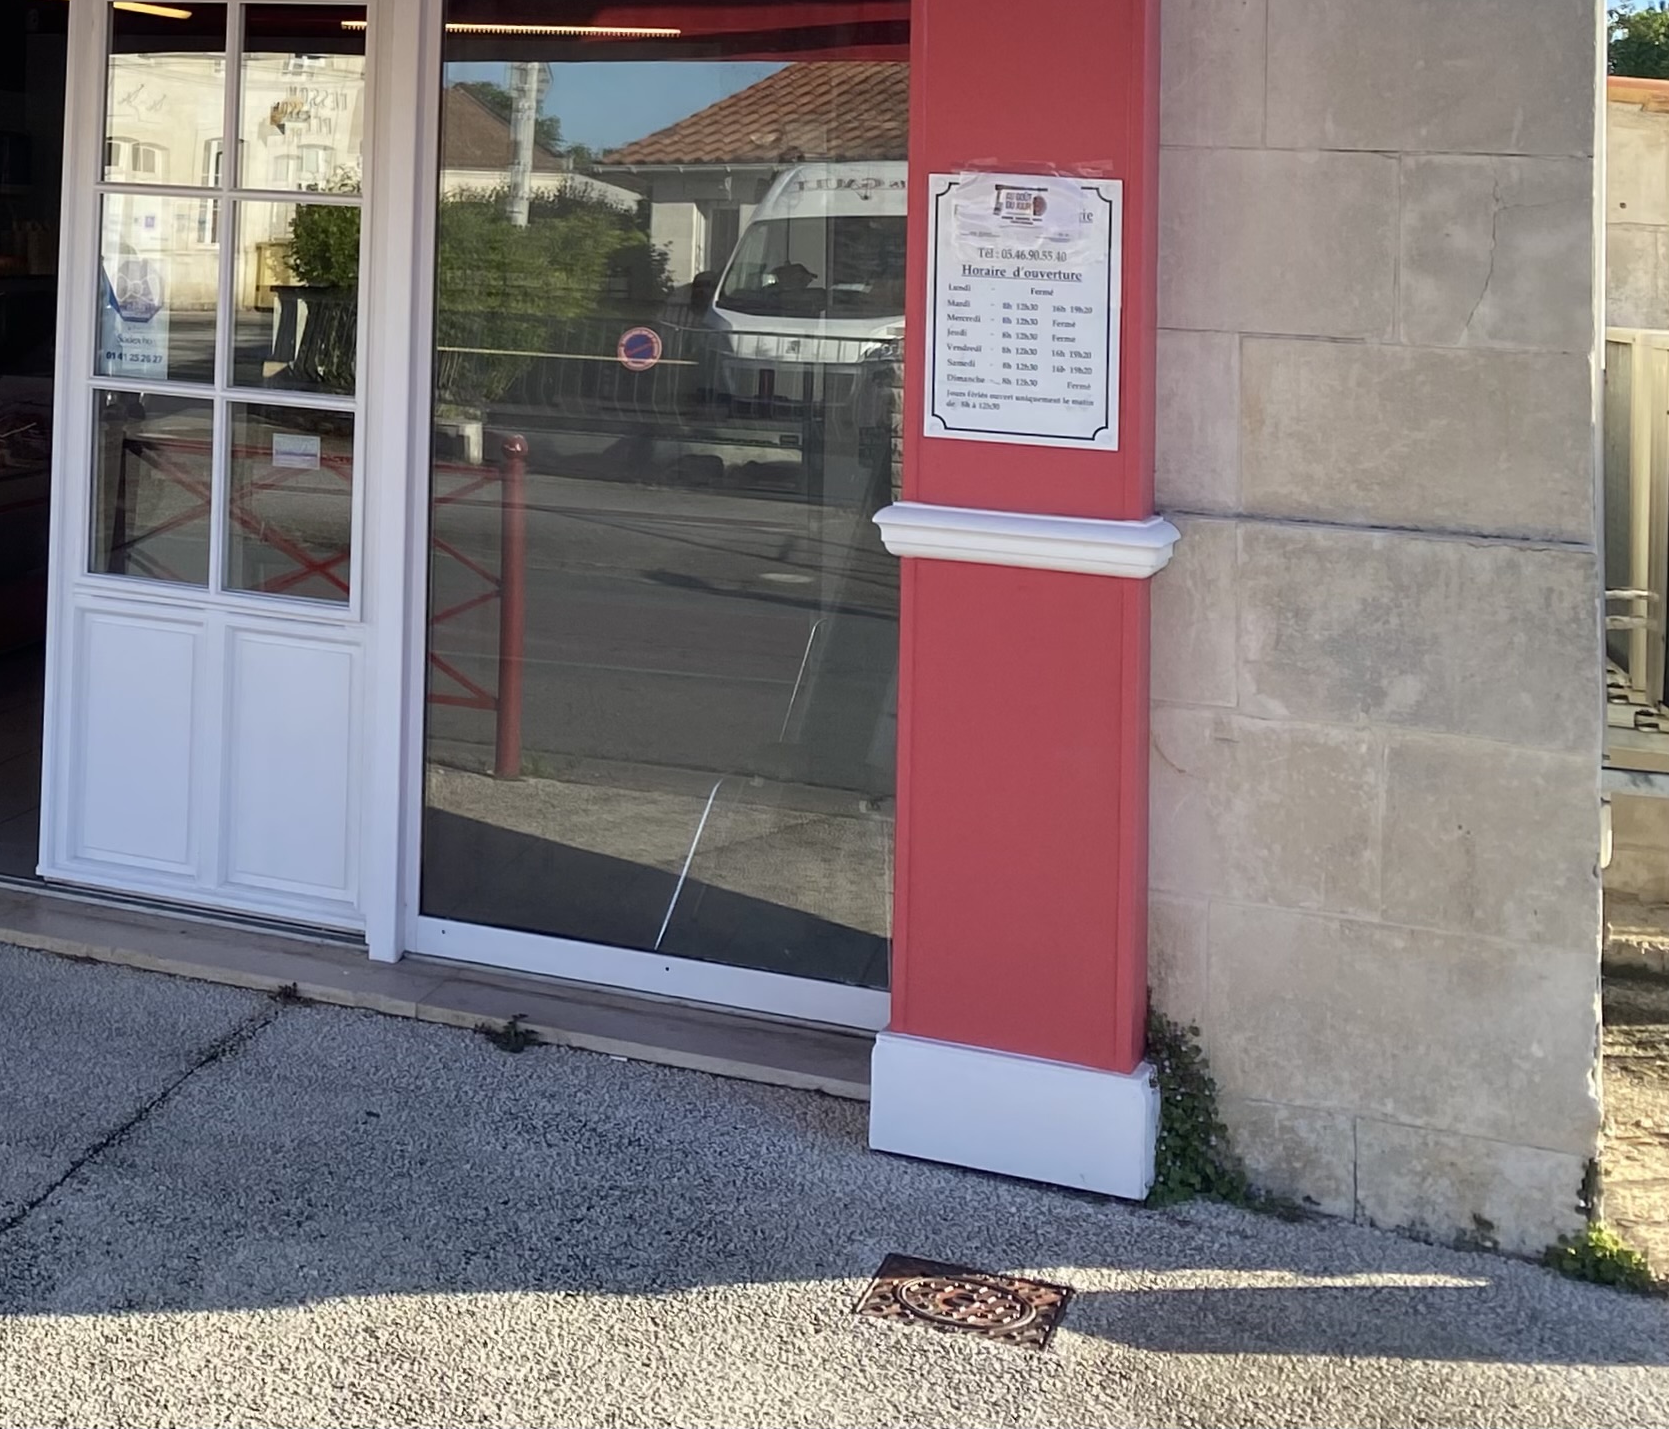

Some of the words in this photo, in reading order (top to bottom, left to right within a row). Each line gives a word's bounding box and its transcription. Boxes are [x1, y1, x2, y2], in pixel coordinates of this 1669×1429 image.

[962, 264, 1007, 276] Horaire
[948, 283, 971, 292] Lundi
[947, 300, 971, 308] Mardi
[1002, 302, 1012, 310] 8h
[1016, 303, 1038, 312] 12h30
[947, 314, 981, 323] Mercredi
[1016, 318, 1038, 326] 12h30
[947, 328, 967, 337] Jeudi
[1016, 333, 1038, 341] 12h30
[947, 343, 982, 352] Vendredi
[1016, 348, 1038, 356] 12h30
[947, 359, 976, 367] Samedi
[1002, 362, 1012, 370] 8h
[1016, 363, 1038, 372] 12h30
[947, 374, 985, 384] Dimanche
[1002, 377, 1012, 385] 8h
[1016, 378, 1038, 387] 12h30
